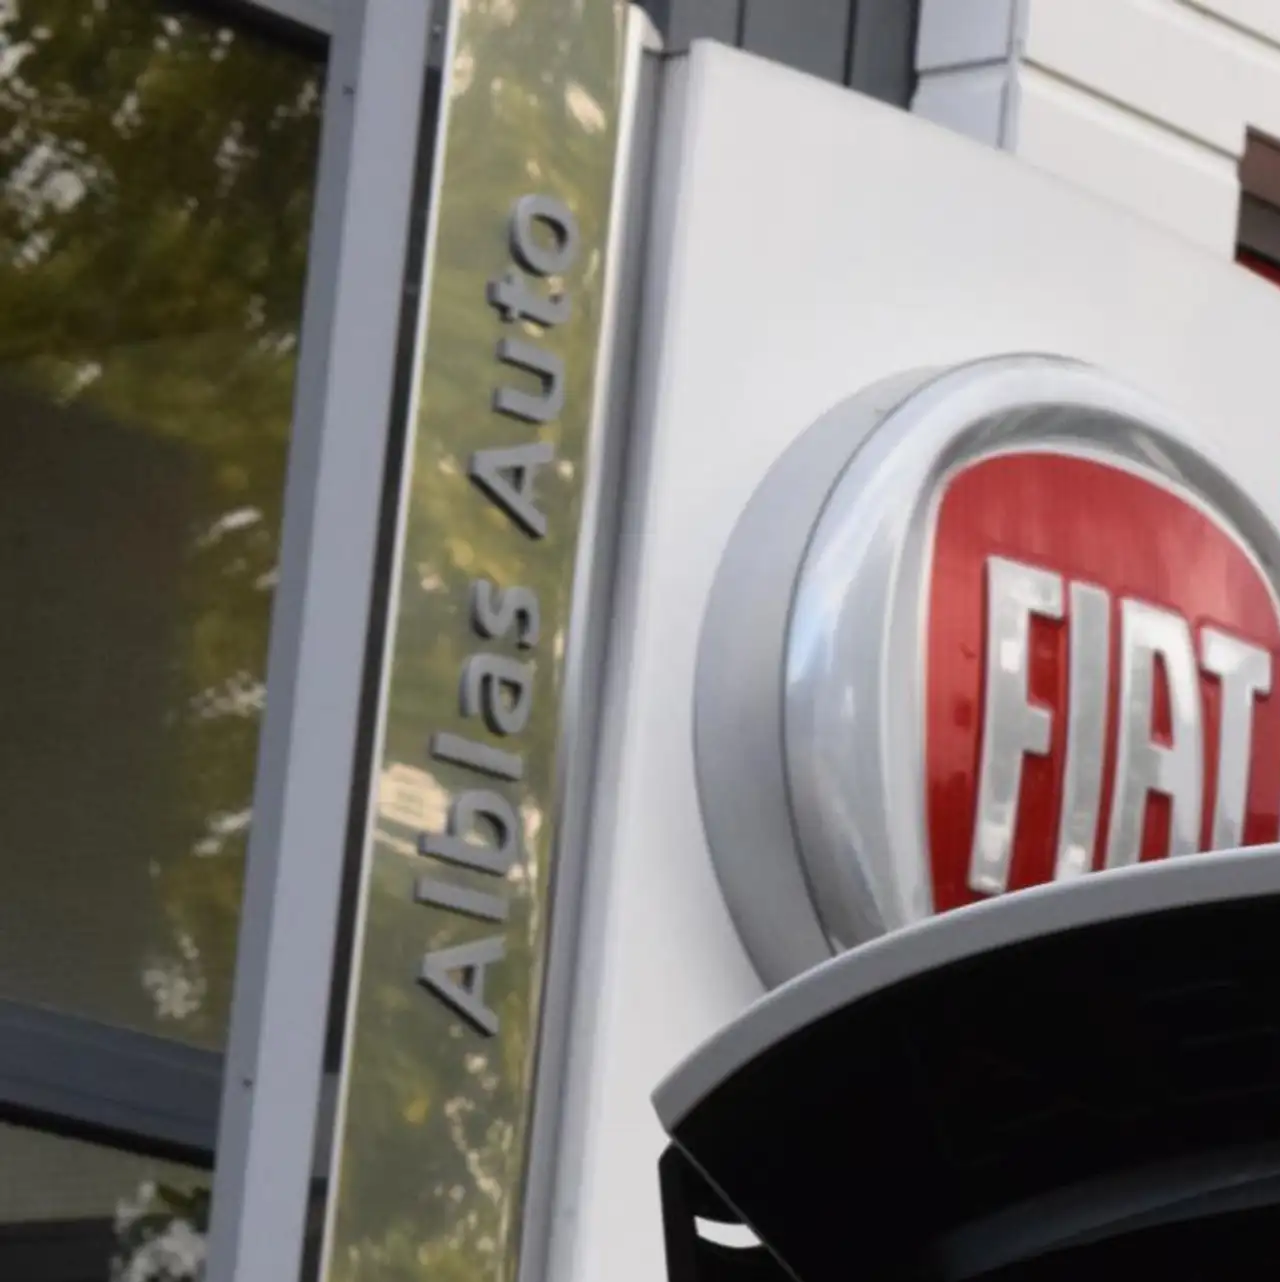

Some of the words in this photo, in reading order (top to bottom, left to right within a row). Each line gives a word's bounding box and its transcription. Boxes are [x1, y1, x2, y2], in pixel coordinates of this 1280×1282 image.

[466, 193, 581, 541] Auto
[414, 577, 541, 1039] Alblas
[968, 554, 1273, 894] FIAT
